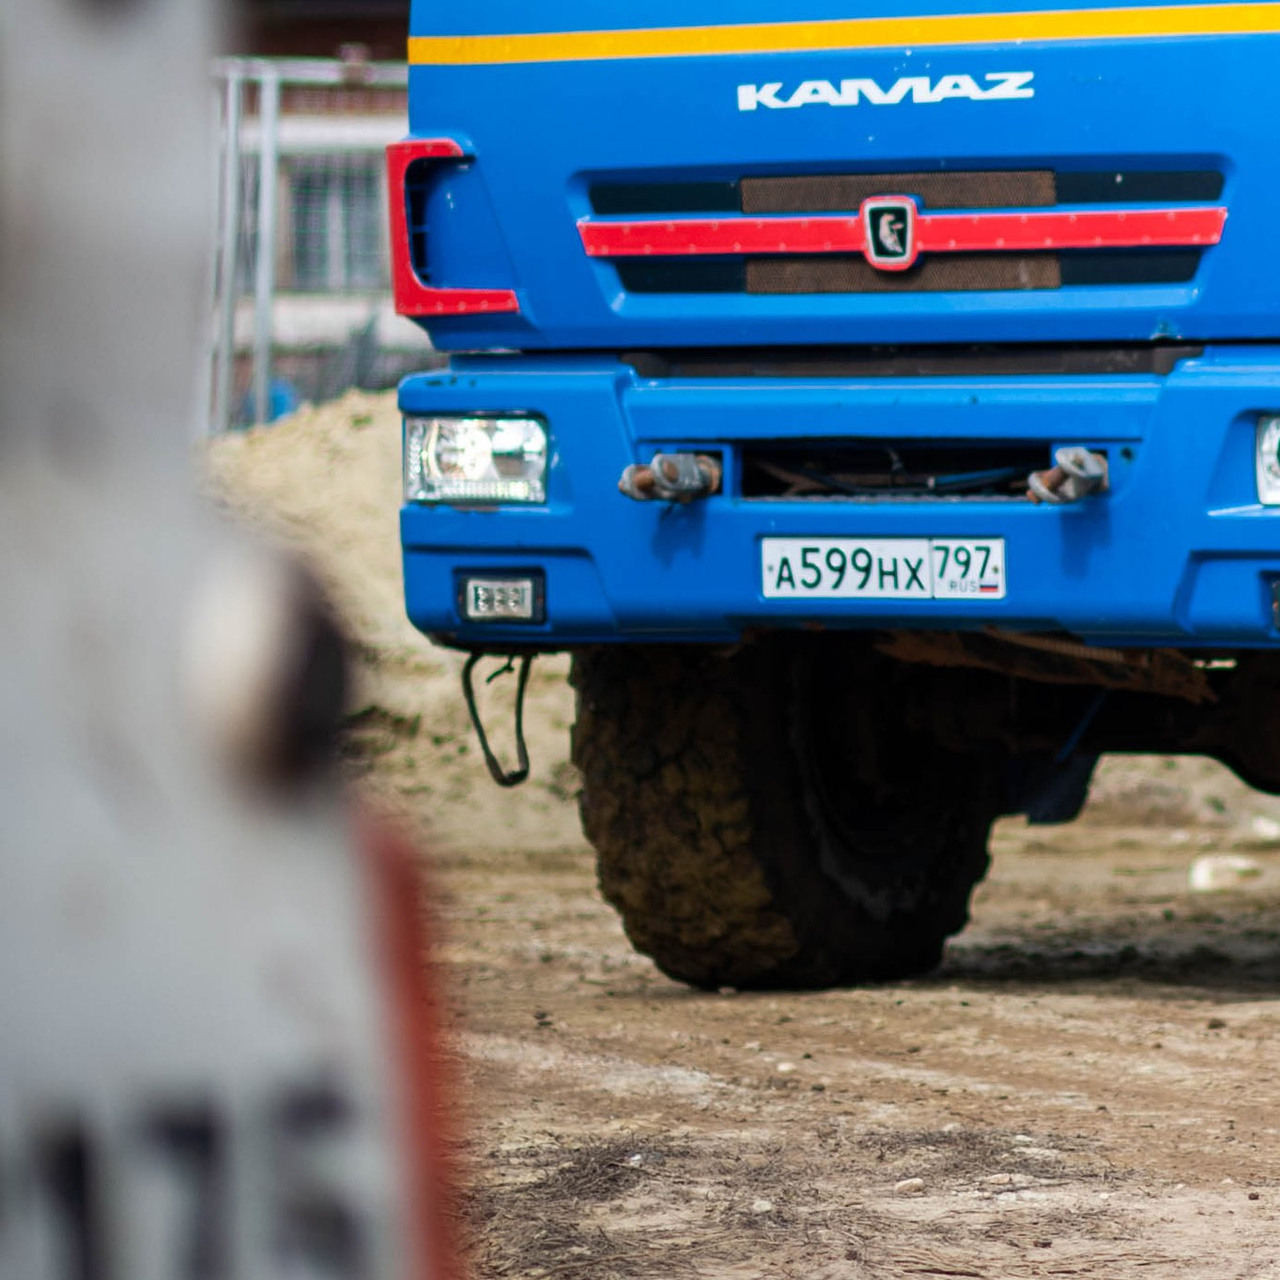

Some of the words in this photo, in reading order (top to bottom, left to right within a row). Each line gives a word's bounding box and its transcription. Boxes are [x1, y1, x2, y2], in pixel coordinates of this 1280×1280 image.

[737, 71, 1035, 111] KAMAZ
[933, 545, 991, 578] 797
[950, 580, 978, 593] RUS
